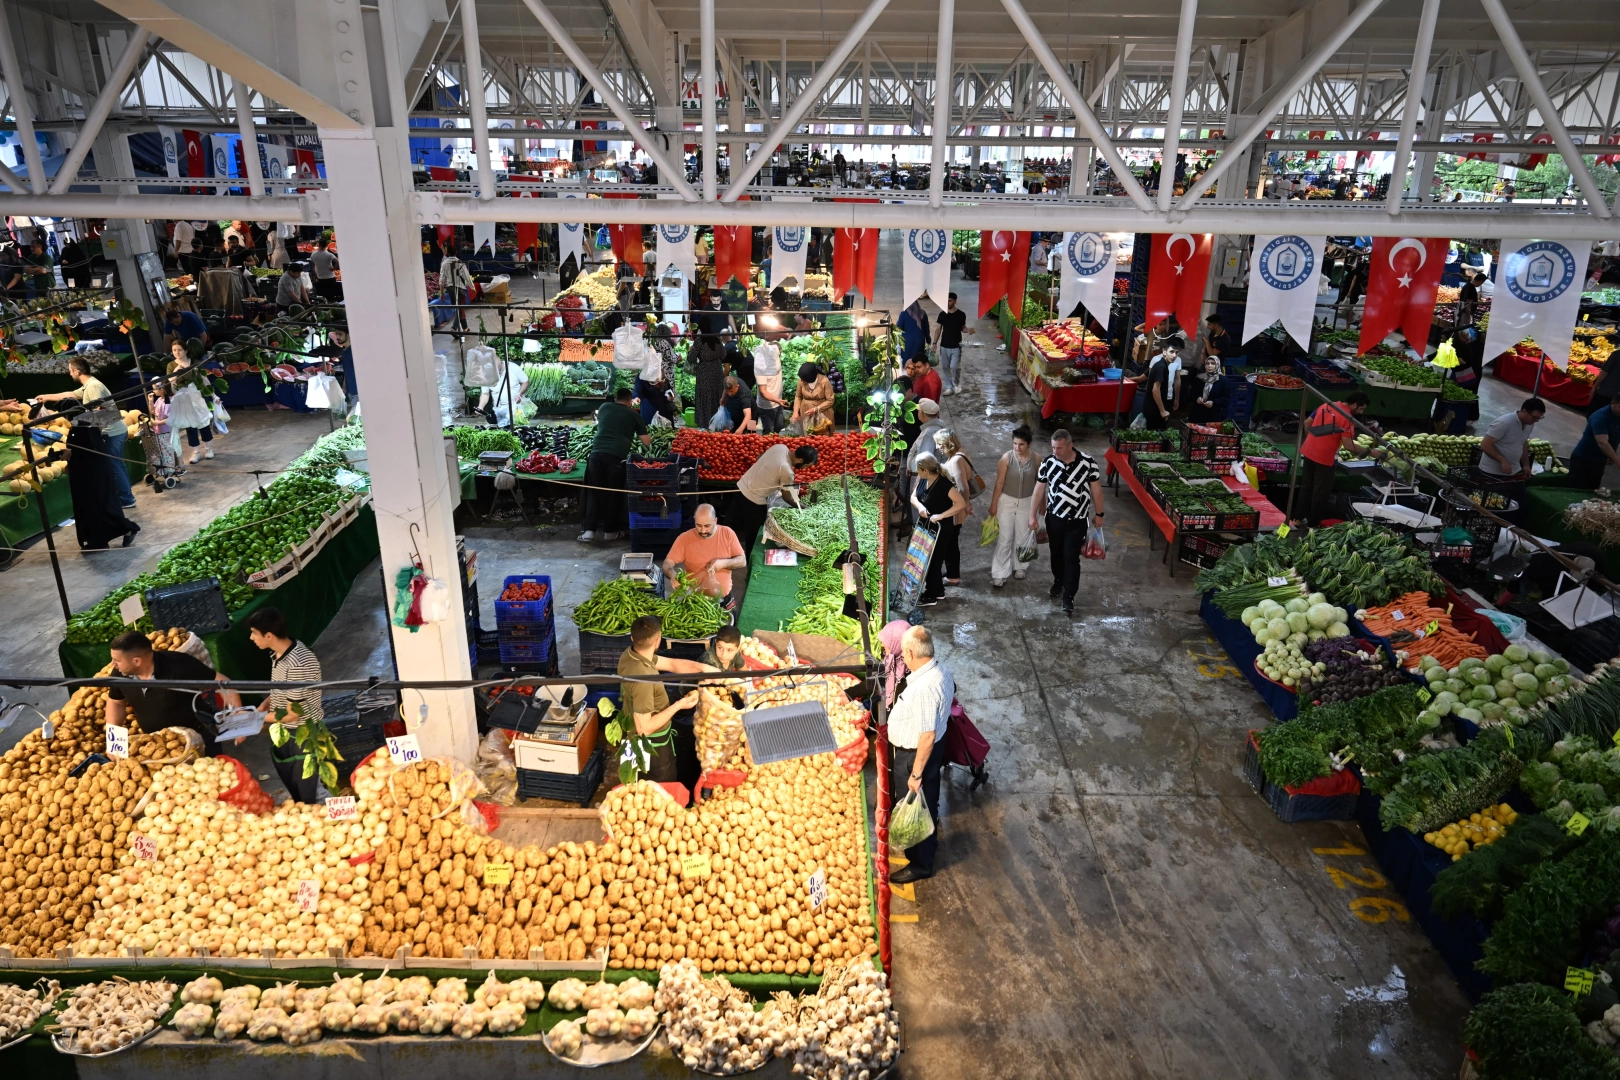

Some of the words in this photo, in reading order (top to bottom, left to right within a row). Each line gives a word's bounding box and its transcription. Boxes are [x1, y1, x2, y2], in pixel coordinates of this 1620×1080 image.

[110, 742, 123, 752] 100
[390, 739, 399, 754] 3
[402, 749, 418, 761] 100
[1312, 846, 1411, 924] 126
